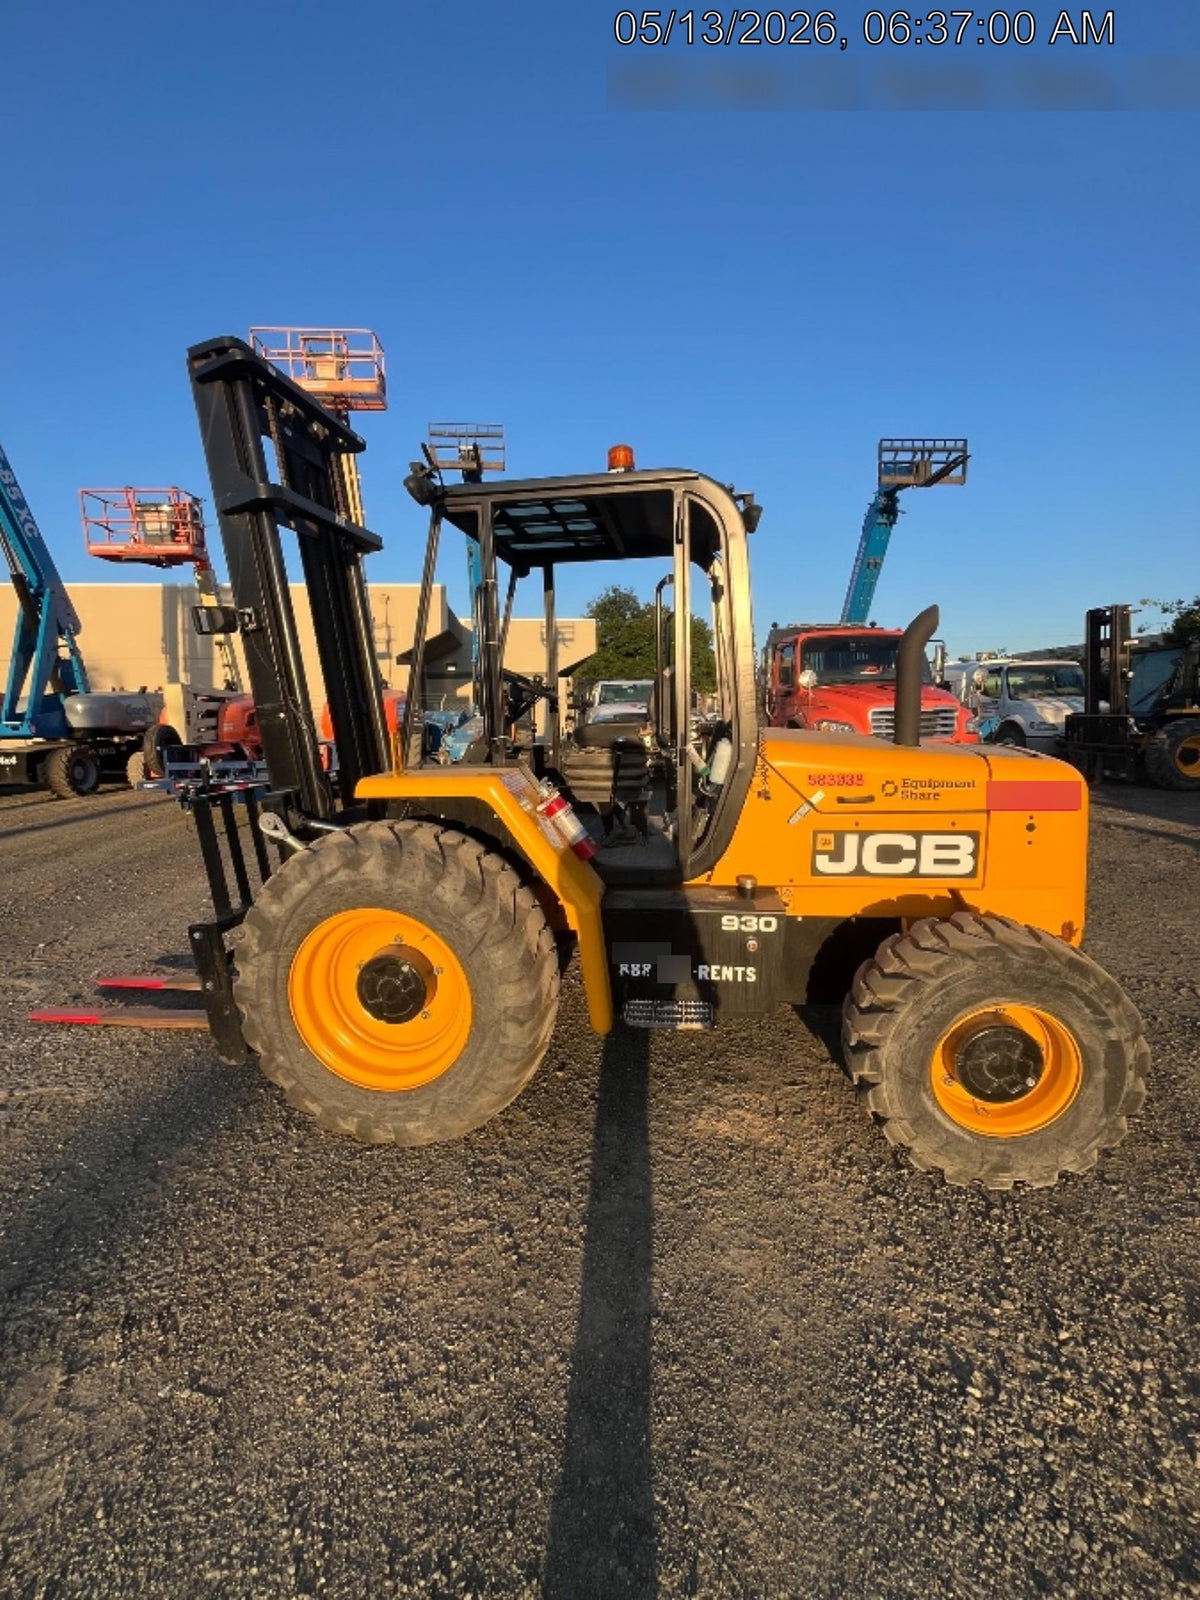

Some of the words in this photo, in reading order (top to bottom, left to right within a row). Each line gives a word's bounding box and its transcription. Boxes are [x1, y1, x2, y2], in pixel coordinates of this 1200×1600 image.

[901, 778, 976, 790] Equipment
[901, 790, 941, 802] Share
[815, 833, 975, 875] JCB
[721, 915, 778, 932] 930
